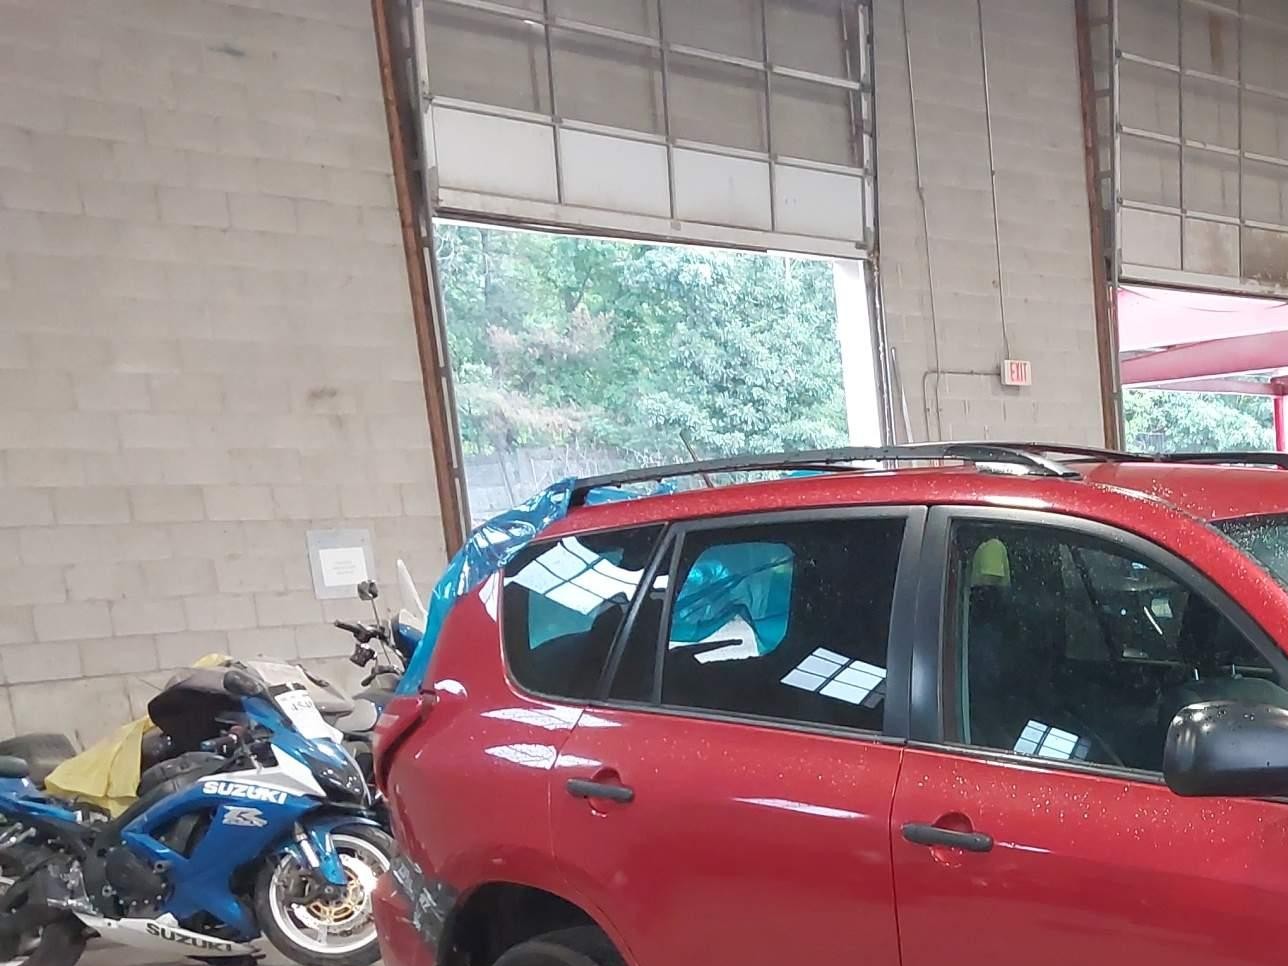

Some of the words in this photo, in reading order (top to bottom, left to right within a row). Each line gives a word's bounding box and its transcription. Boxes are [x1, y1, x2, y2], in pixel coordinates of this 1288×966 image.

[1010, 362, 1027, 383] EXIT
[202, 781, 288, 805] SUZUKI
[146, 922, 232, 951] SUZUKI
